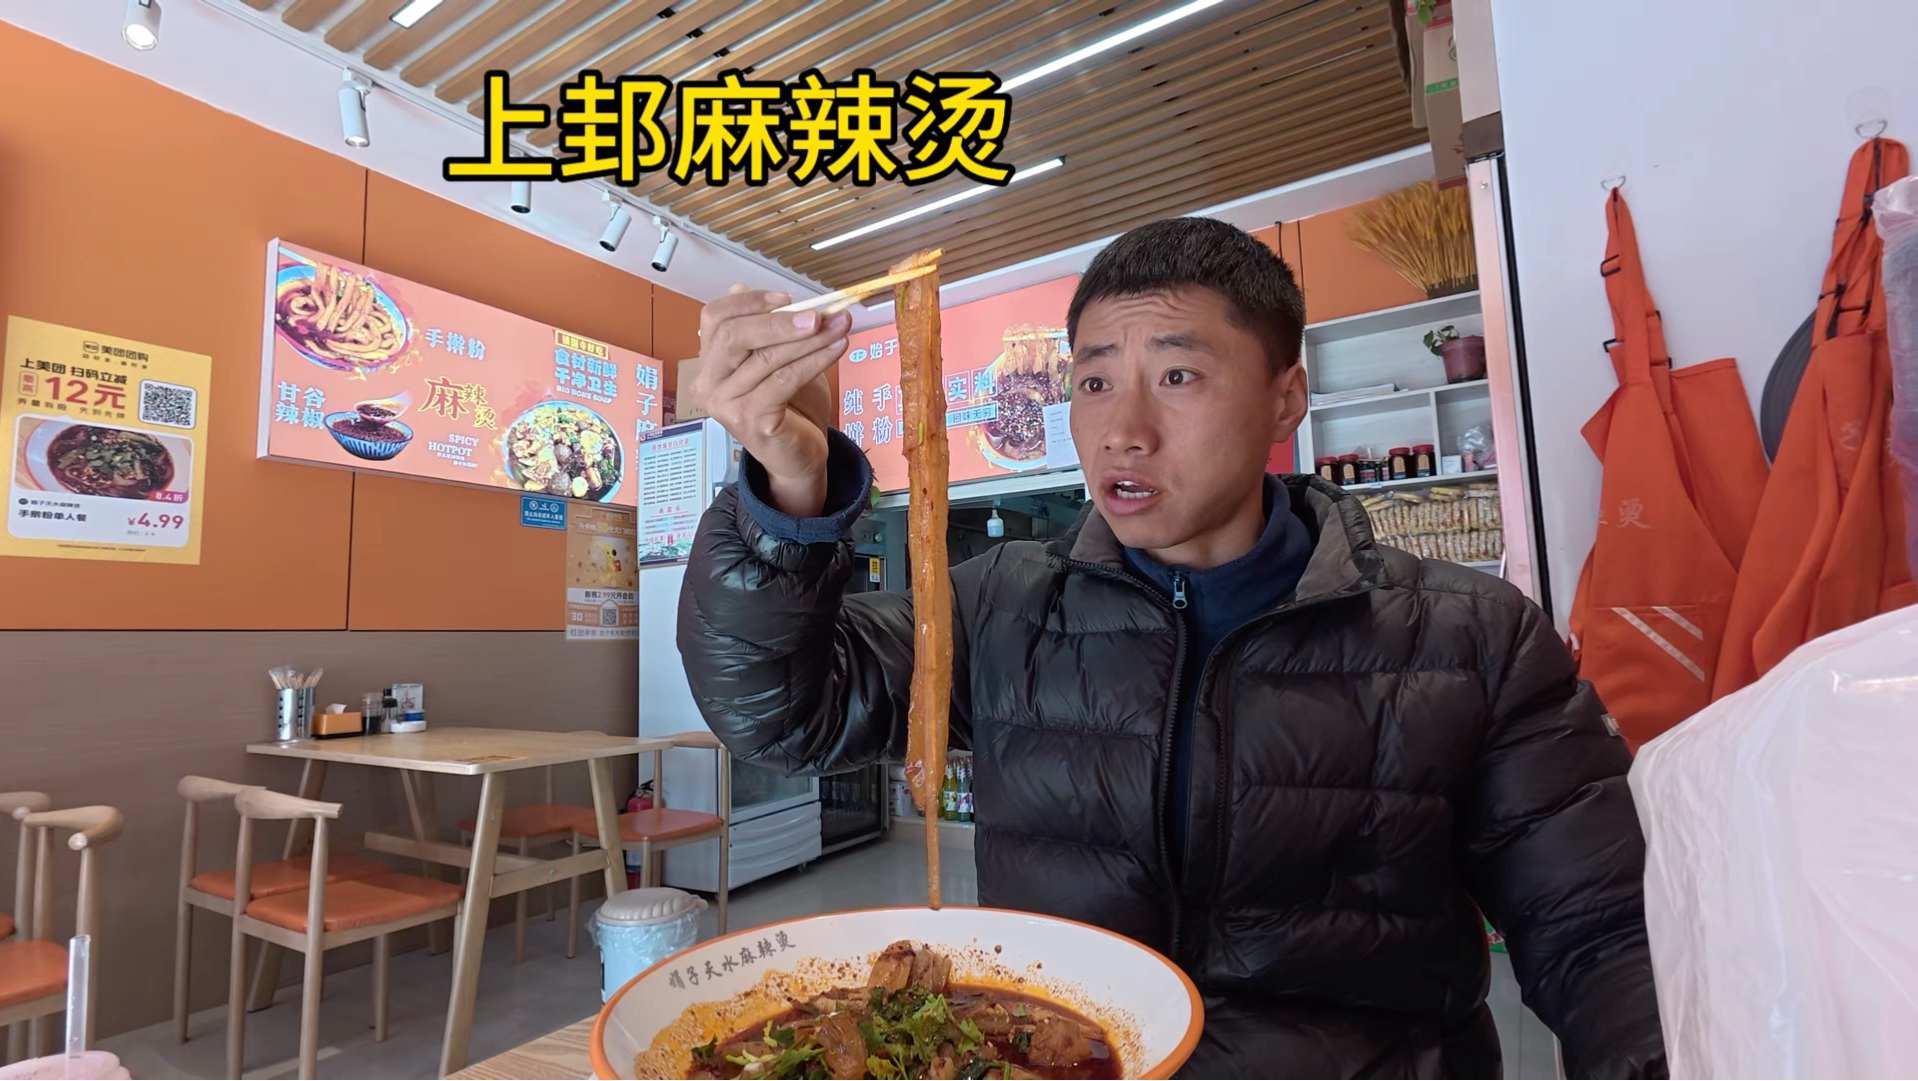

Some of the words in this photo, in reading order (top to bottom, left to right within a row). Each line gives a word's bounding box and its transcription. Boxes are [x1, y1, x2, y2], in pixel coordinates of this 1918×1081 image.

[101, 345, 149, 362] 美团团购
[425, 327, 486, 360] 手擀粉
[869, 338, 898, 360] 始于
[20, 358, 66, 375] 上美团
[70, 366, 127, 385] 扫码立减
[554, 347, 617, 379] 食材新鲜
[45, 376, 126, 409] 12元
[277, 381, 325, 408] 甘谷
[554, 366, 617, 397] 干净卫生
[418, 376, 498, 430] 麻辣烫
[592, 394, 612, 404] SOUP
[275, 401, 326, 430] 辣椒
[428, 441, 473, 457] HOTPOT
[448, 433, 479, 447] SPICY
[155, 492, 183, 502] 8.4折
[18, 509, 87, 522] 手擀粉单人餐
[669, 930, 796, 989] 娟子天水麻辣烫
